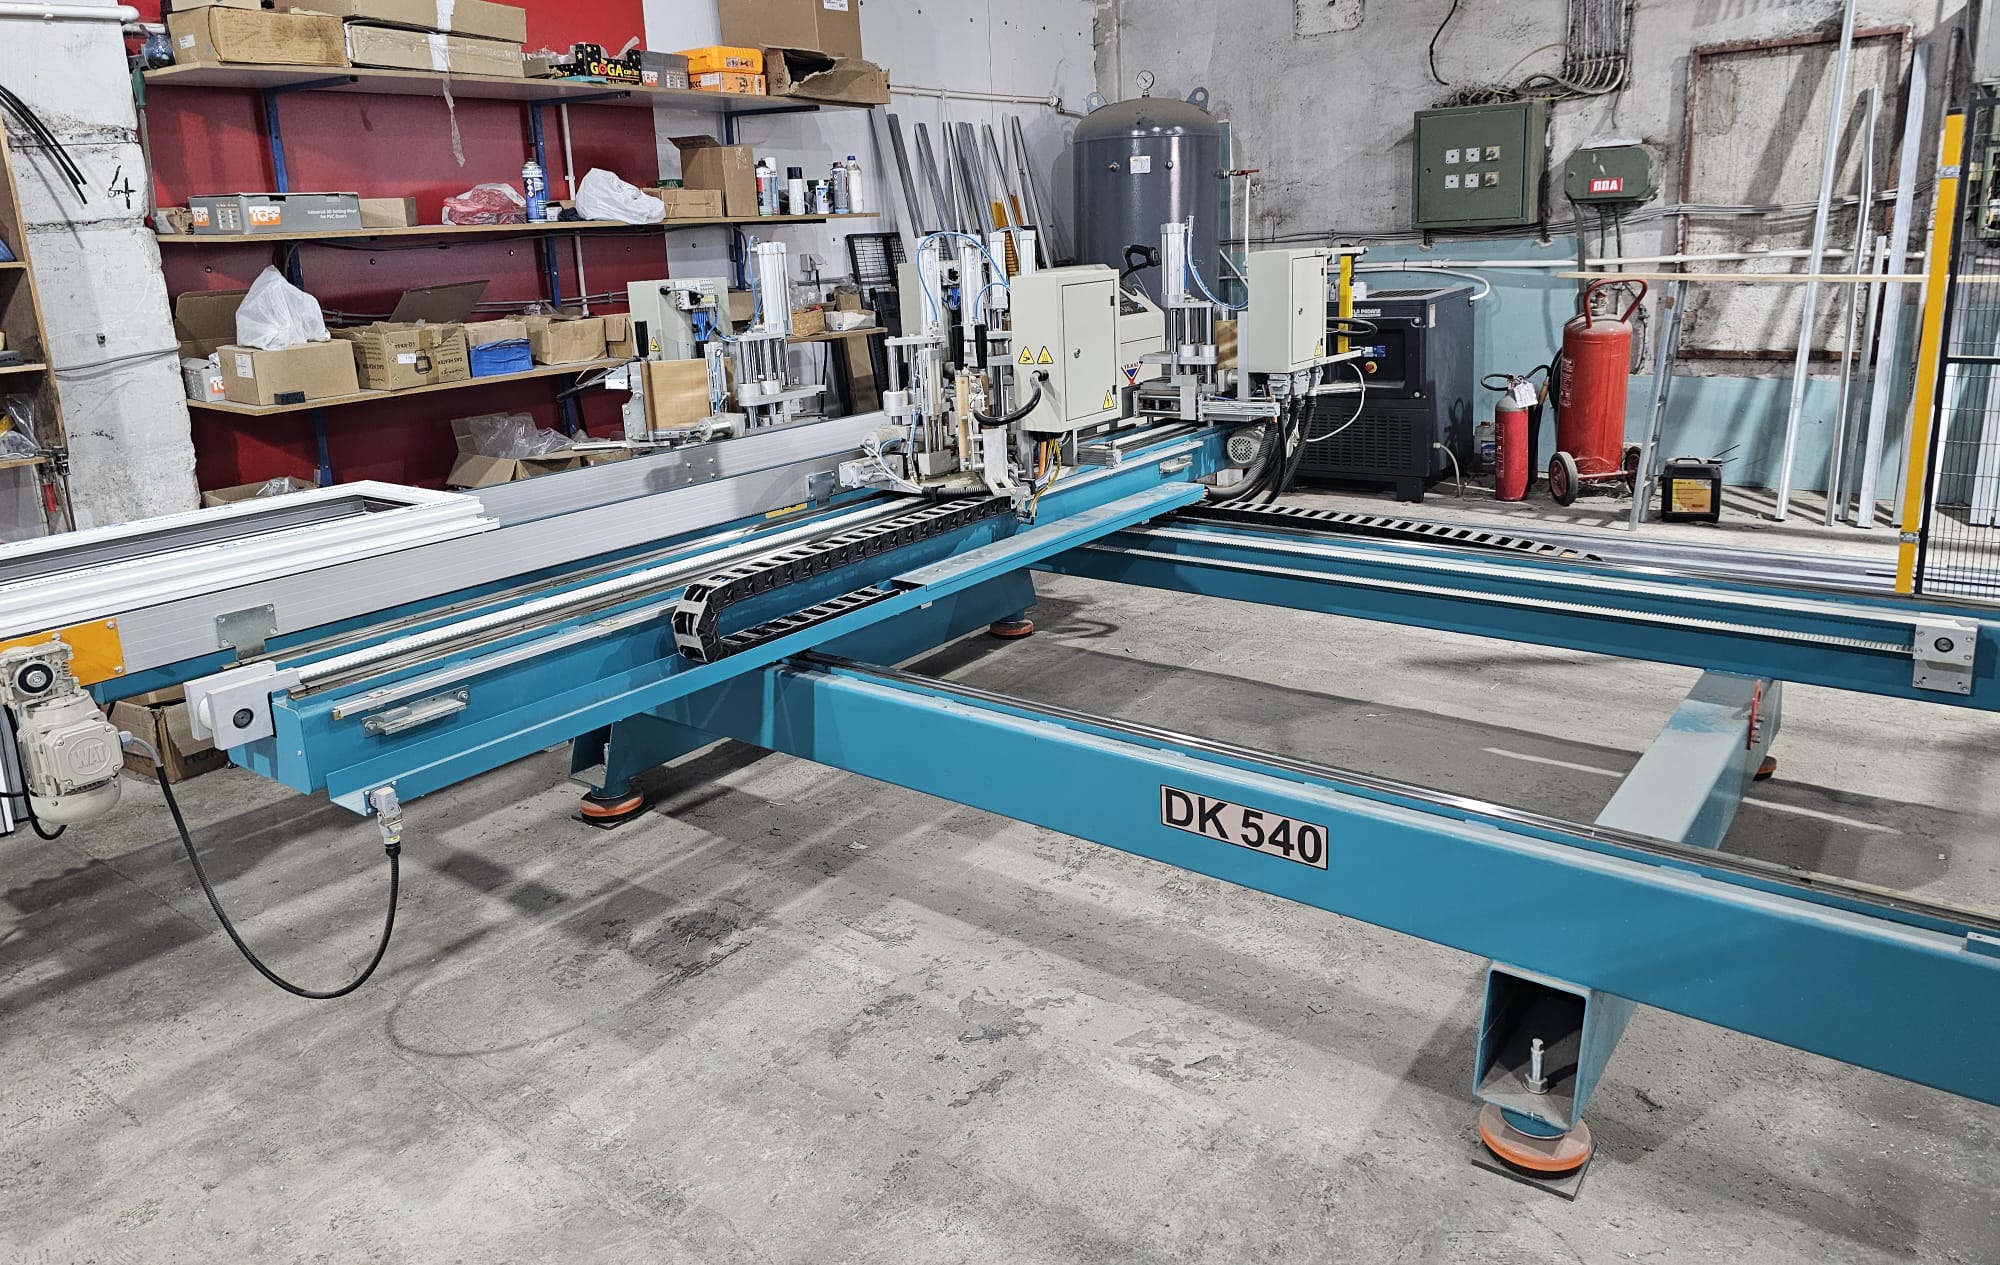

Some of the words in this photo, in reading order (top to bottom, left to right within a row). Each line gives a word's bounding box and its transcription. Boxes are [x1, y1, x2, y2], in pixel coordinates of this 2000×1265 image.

[590, 62, 624, 77] GOGA
[107, 164, 137, 209] 4
[71, 742, 106, 769] WAT
[1165, 788, 1229, 840] DK
[1240, 809, 1322, 864] 540
